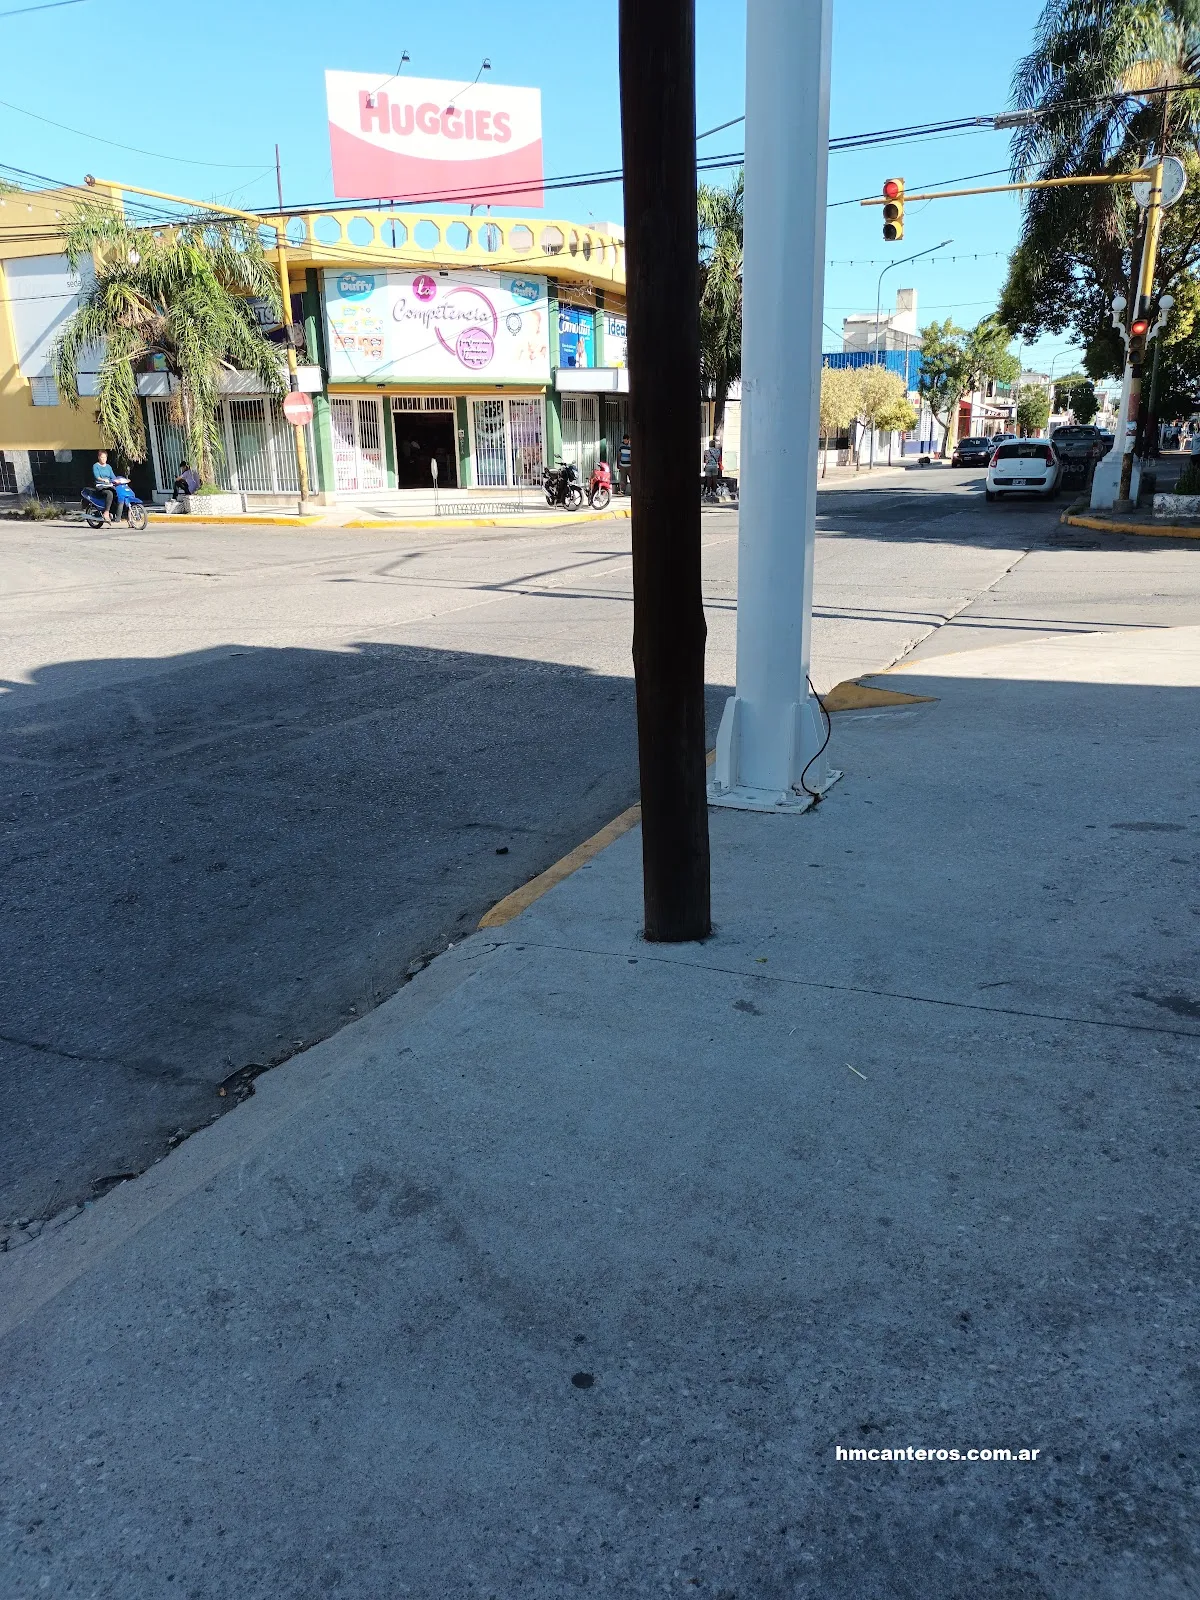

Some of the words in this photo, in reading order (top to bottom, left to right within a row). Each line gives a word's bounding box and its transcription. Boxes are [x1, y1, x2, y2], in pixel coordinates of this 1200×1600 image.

[358, 89, 512, 144] HUGGIES
[340, 280, 373, 292] Duffy
[392, 298, 492, 329] Competencia
